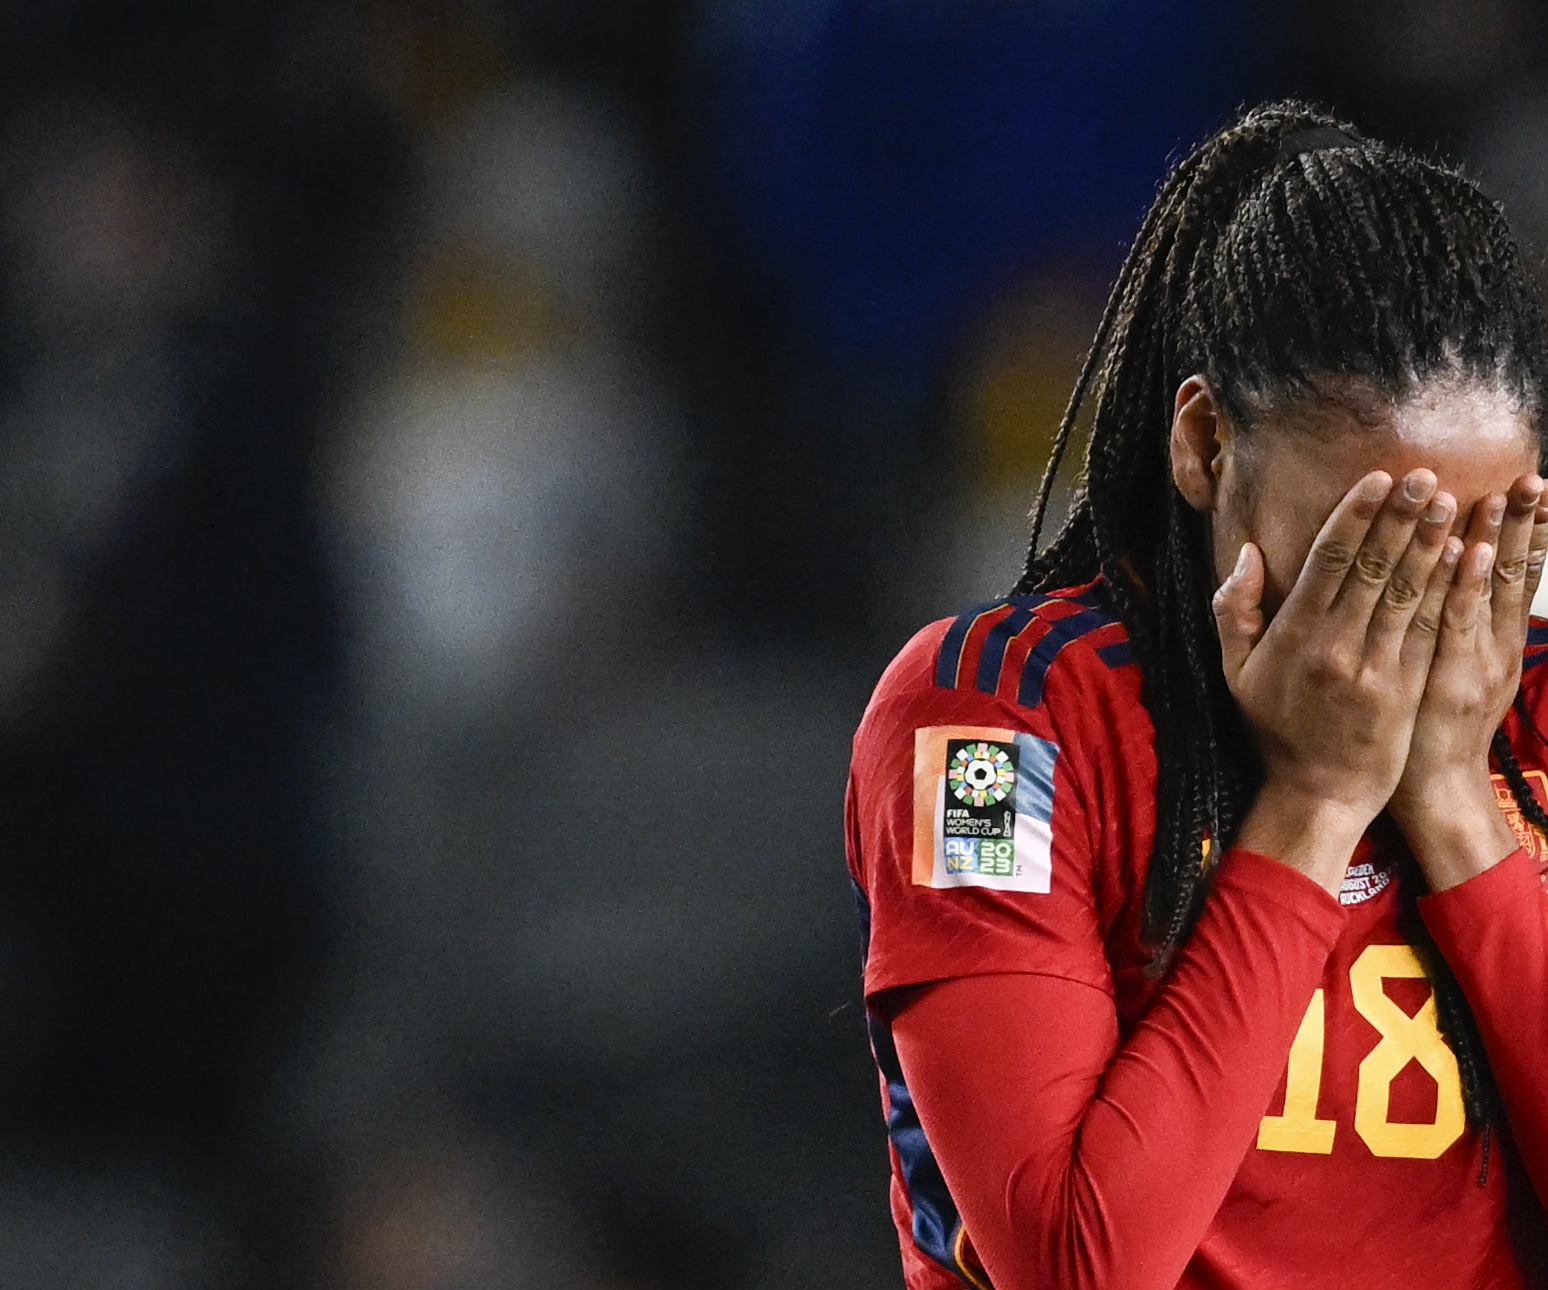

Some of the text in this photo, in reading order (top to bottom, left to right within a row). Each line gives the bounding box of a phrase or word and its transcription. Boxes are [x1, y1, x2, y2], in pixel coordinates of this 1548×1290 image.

[946, 809, 970, 818] FIFA
[946, 818, 992, 827] WOMEN'S
[946, 826, 1001, 836] WORLD CUP
[945, 840, 974, 856] AU
[980, 842, 1012, 858] 20
[946, 856, 975, 871] NZ
[979, 857, 1010, 873] 23
[1256, 944, 1467, 1159] 18
